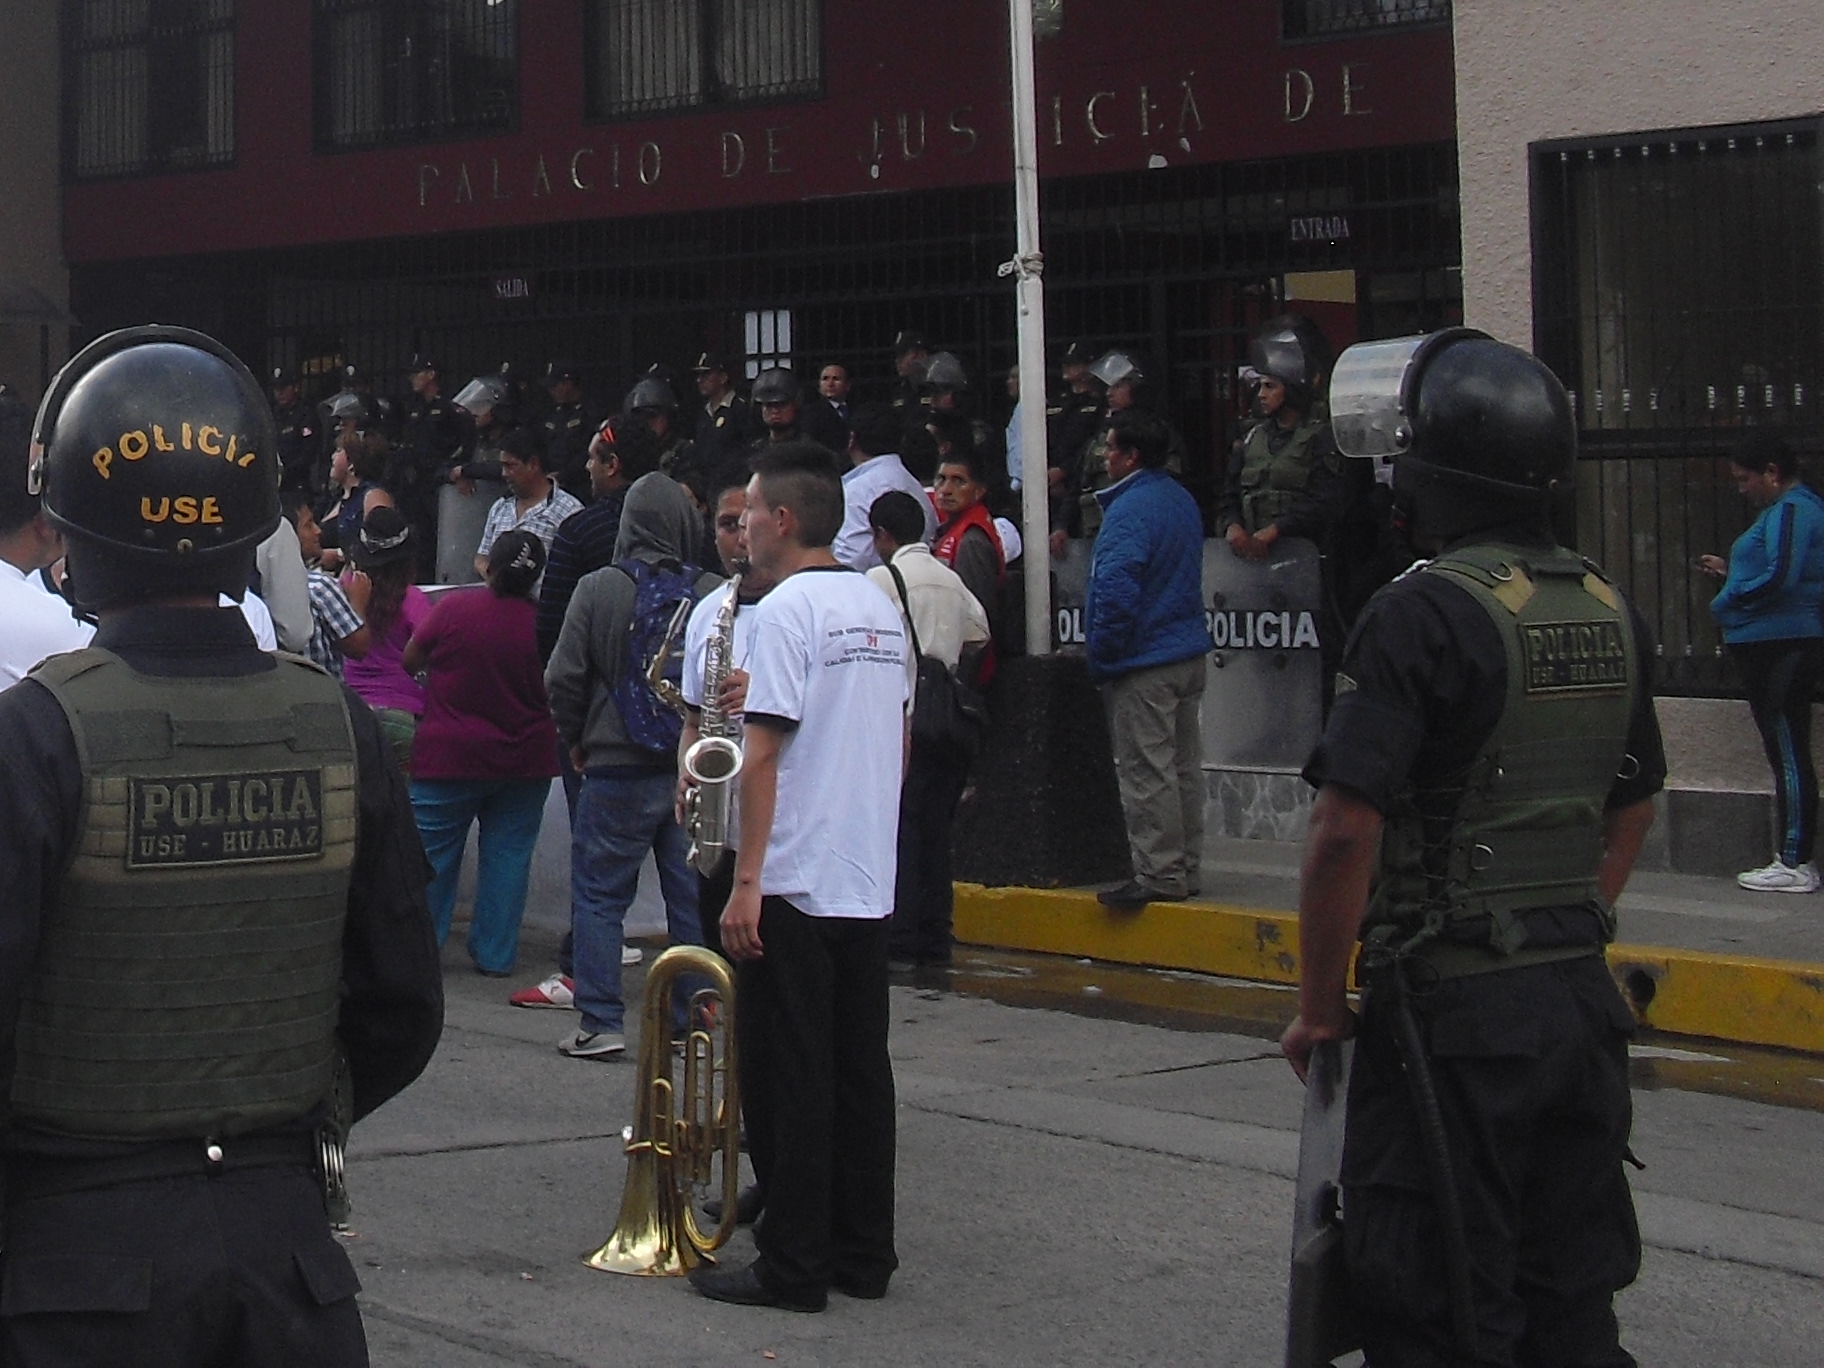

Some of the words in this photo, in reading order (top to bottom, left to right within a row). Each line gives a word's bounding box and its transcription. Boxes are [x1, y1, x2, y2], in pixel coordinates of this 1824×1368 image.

[418, 142, 663, 206] PALACIO
[721, 125, 793, 178] DE
[857, 80, 1204, 162] JUSICIA
[1284, 63, 1372, 122] DE
[1291, 216, 1350, 241] ENTRADA
[140, 495, 224, 524] USE
[1527, 626, 1623, 661] POLICIA
[141, 776, 317, 829] POLICIA
[139, 834, 187, 856] USE
[223, 826, 318, 852] HUARAZ
